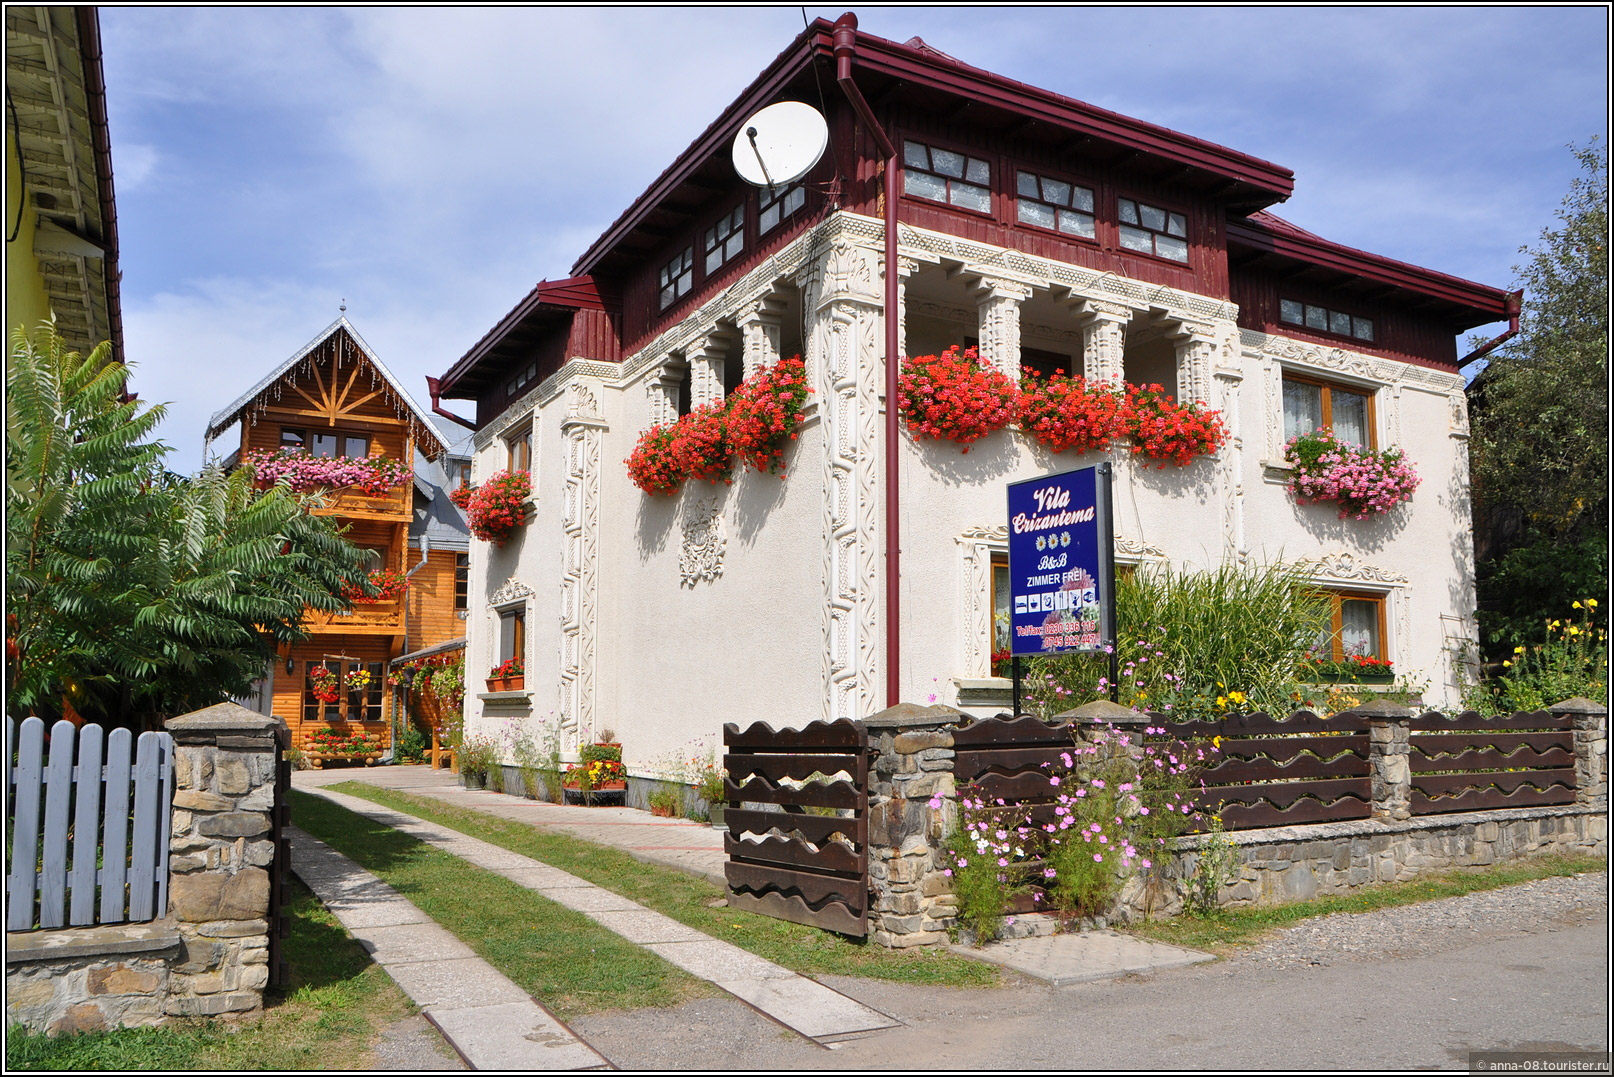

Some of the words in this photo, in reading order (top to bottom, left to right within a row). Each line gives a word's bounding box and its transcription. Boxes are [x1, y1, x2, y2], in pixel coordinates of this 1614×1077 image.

[1034, 486, 1070, 512] Vila
[1012, 505, 1094, 534] Crizantema
[1037, 552, 1067, 570] B&B
[1026, 574, 1060, 587] ZIMMER
[1062, 570, 1082, 583] FREI
[1044, 622, 1064, 634] 0230
[1065, 621, 1080, 632] 336
